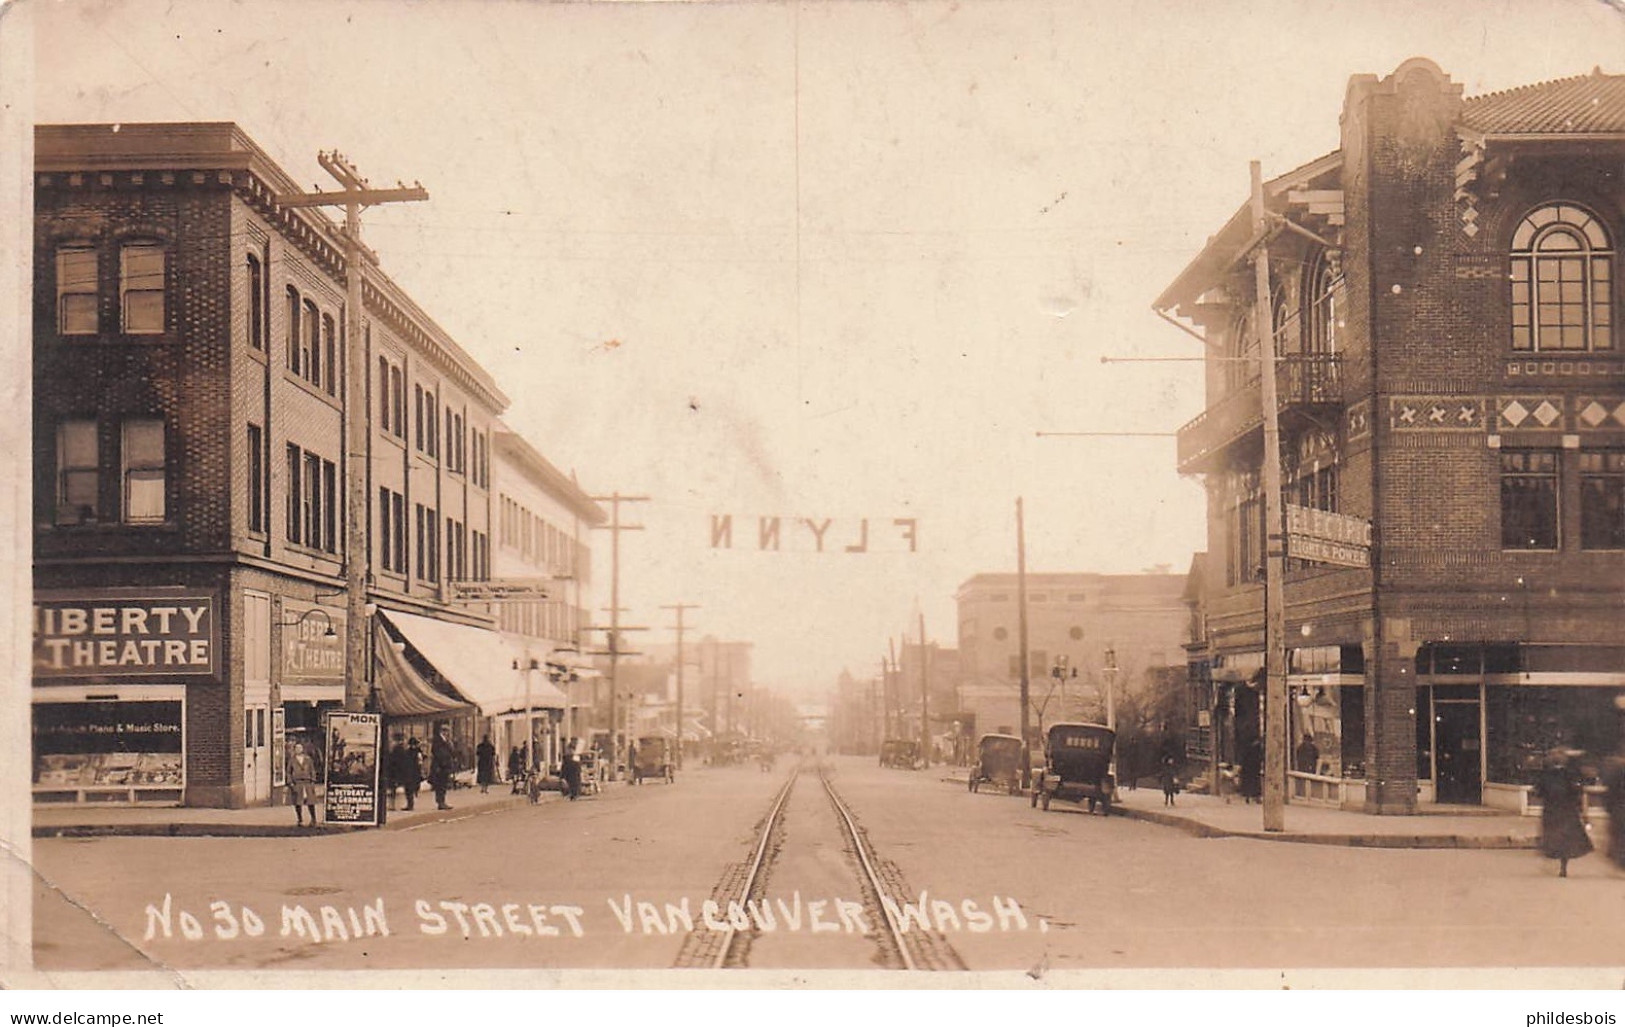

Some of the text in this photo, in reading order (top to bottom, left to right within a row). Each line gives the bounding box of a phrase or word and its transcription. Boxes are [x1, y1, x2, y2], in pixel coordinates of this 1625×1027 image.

[44, 638, 209, 669] THEATRE
[350, 715, 377, 724] MON
[116, 724, 124, 732] &
[126, 724, 151, 733] Music
